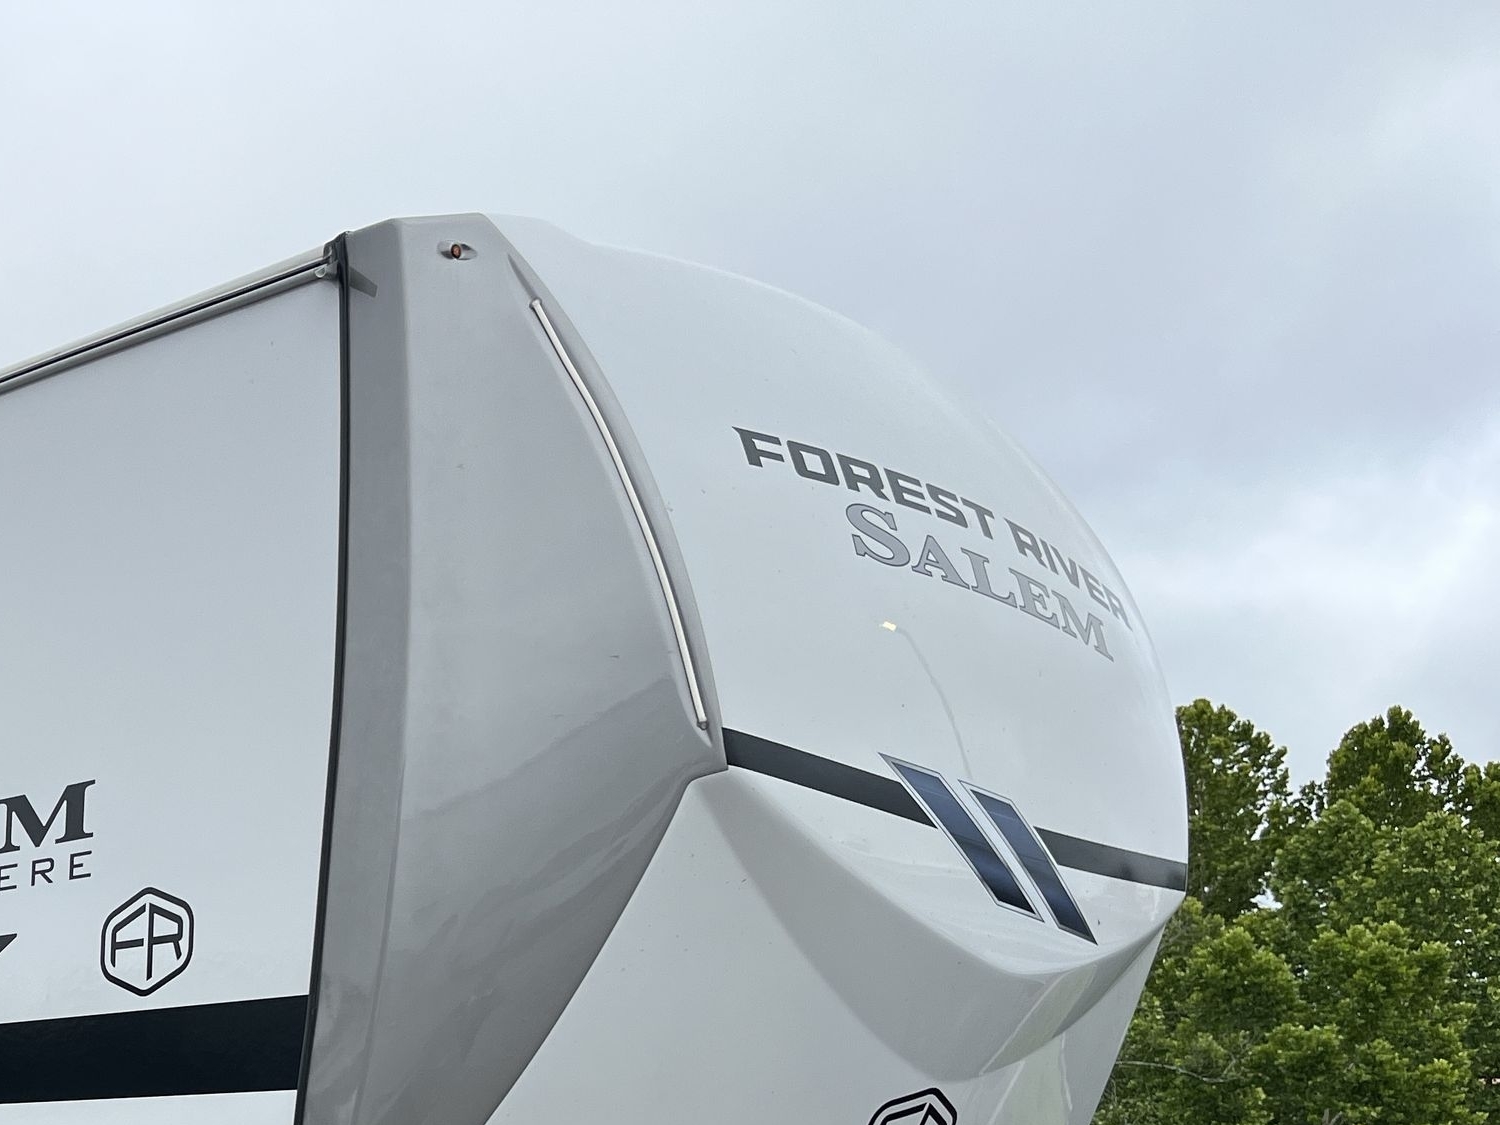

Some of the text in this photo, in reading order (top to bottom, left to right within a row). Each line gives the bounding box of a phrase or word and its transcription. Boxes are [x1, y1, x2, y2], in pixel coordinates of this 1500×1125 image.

[731, 425, 1133, 632] FOREST RIVER
[845, 502, 1115, 663] SALEM
